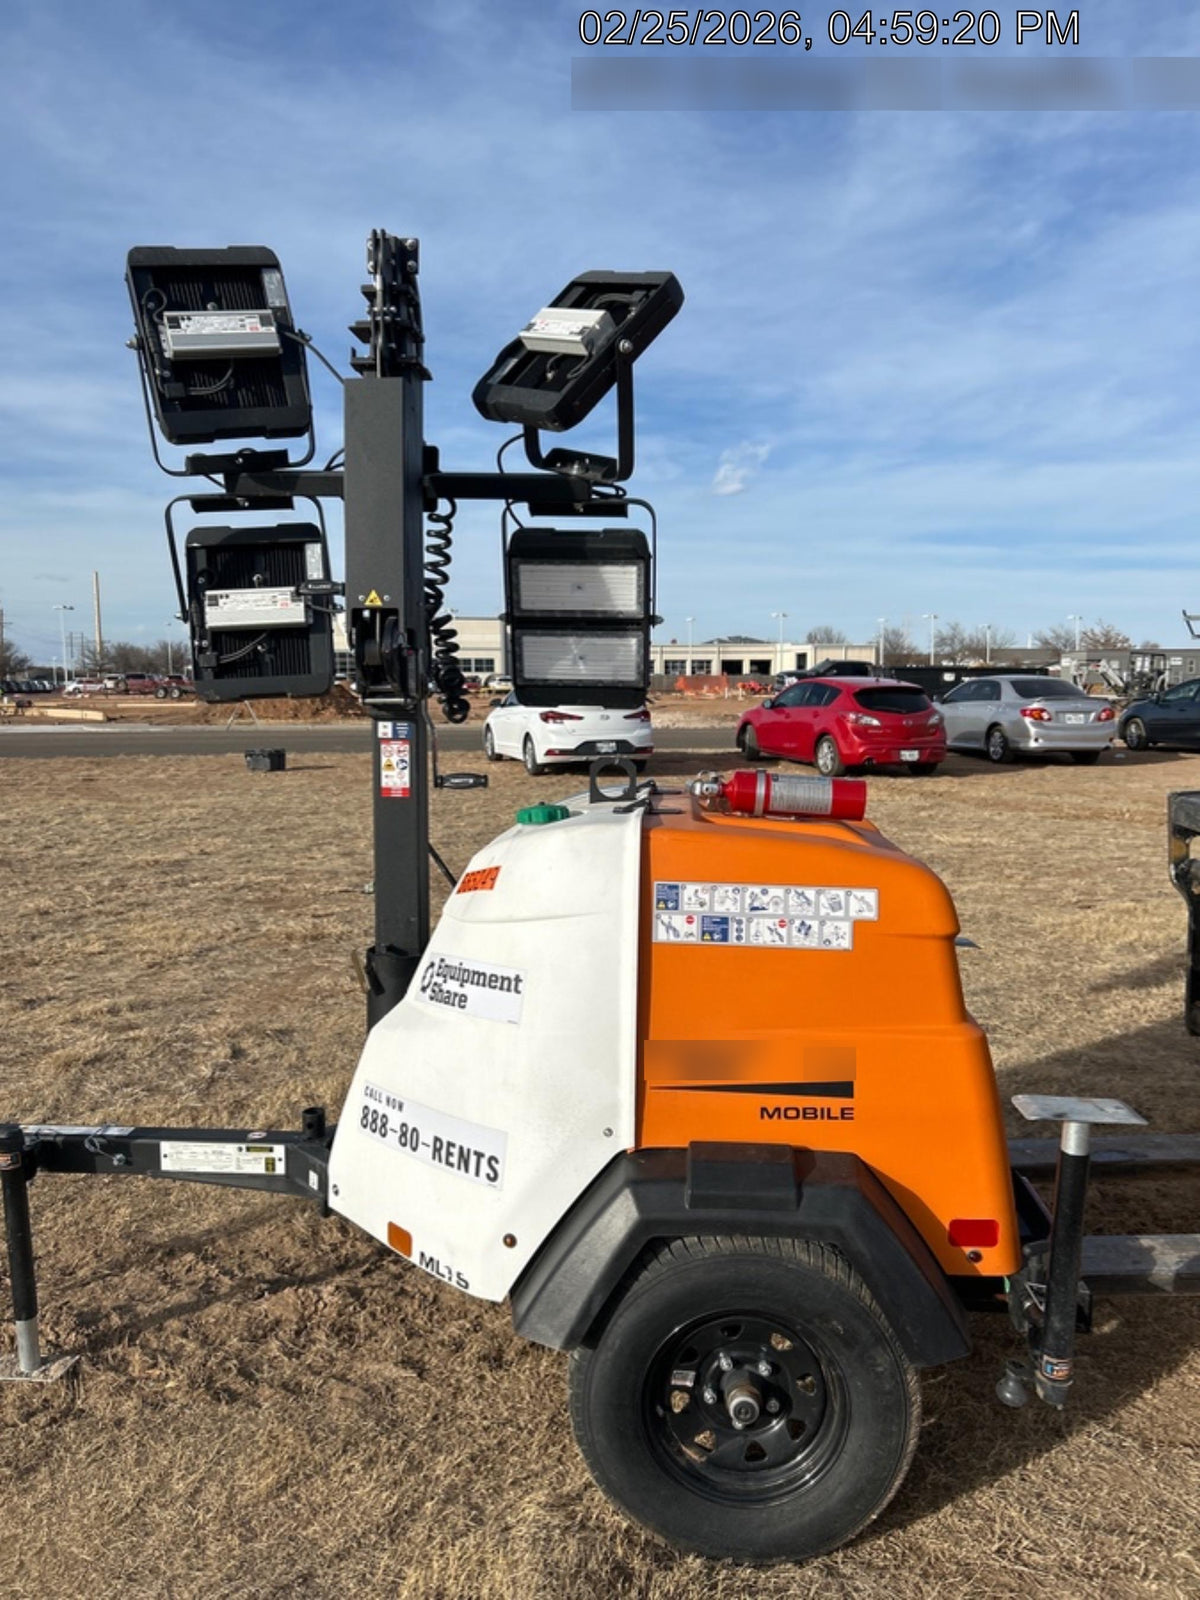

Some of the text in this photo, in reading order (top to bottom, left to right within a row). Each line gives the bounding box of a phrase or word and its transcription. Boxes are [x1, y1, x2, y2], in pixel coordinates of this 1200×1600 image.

[435, 957, 523, 995] Equipment
[428, 981, 469, 1010] Share
[363, 1084, 405, 1113] CALL NOW
[759, 1106, 855, 1121] MOBILE
[360, 1104, 500, 1183] 888-80-RENTS
